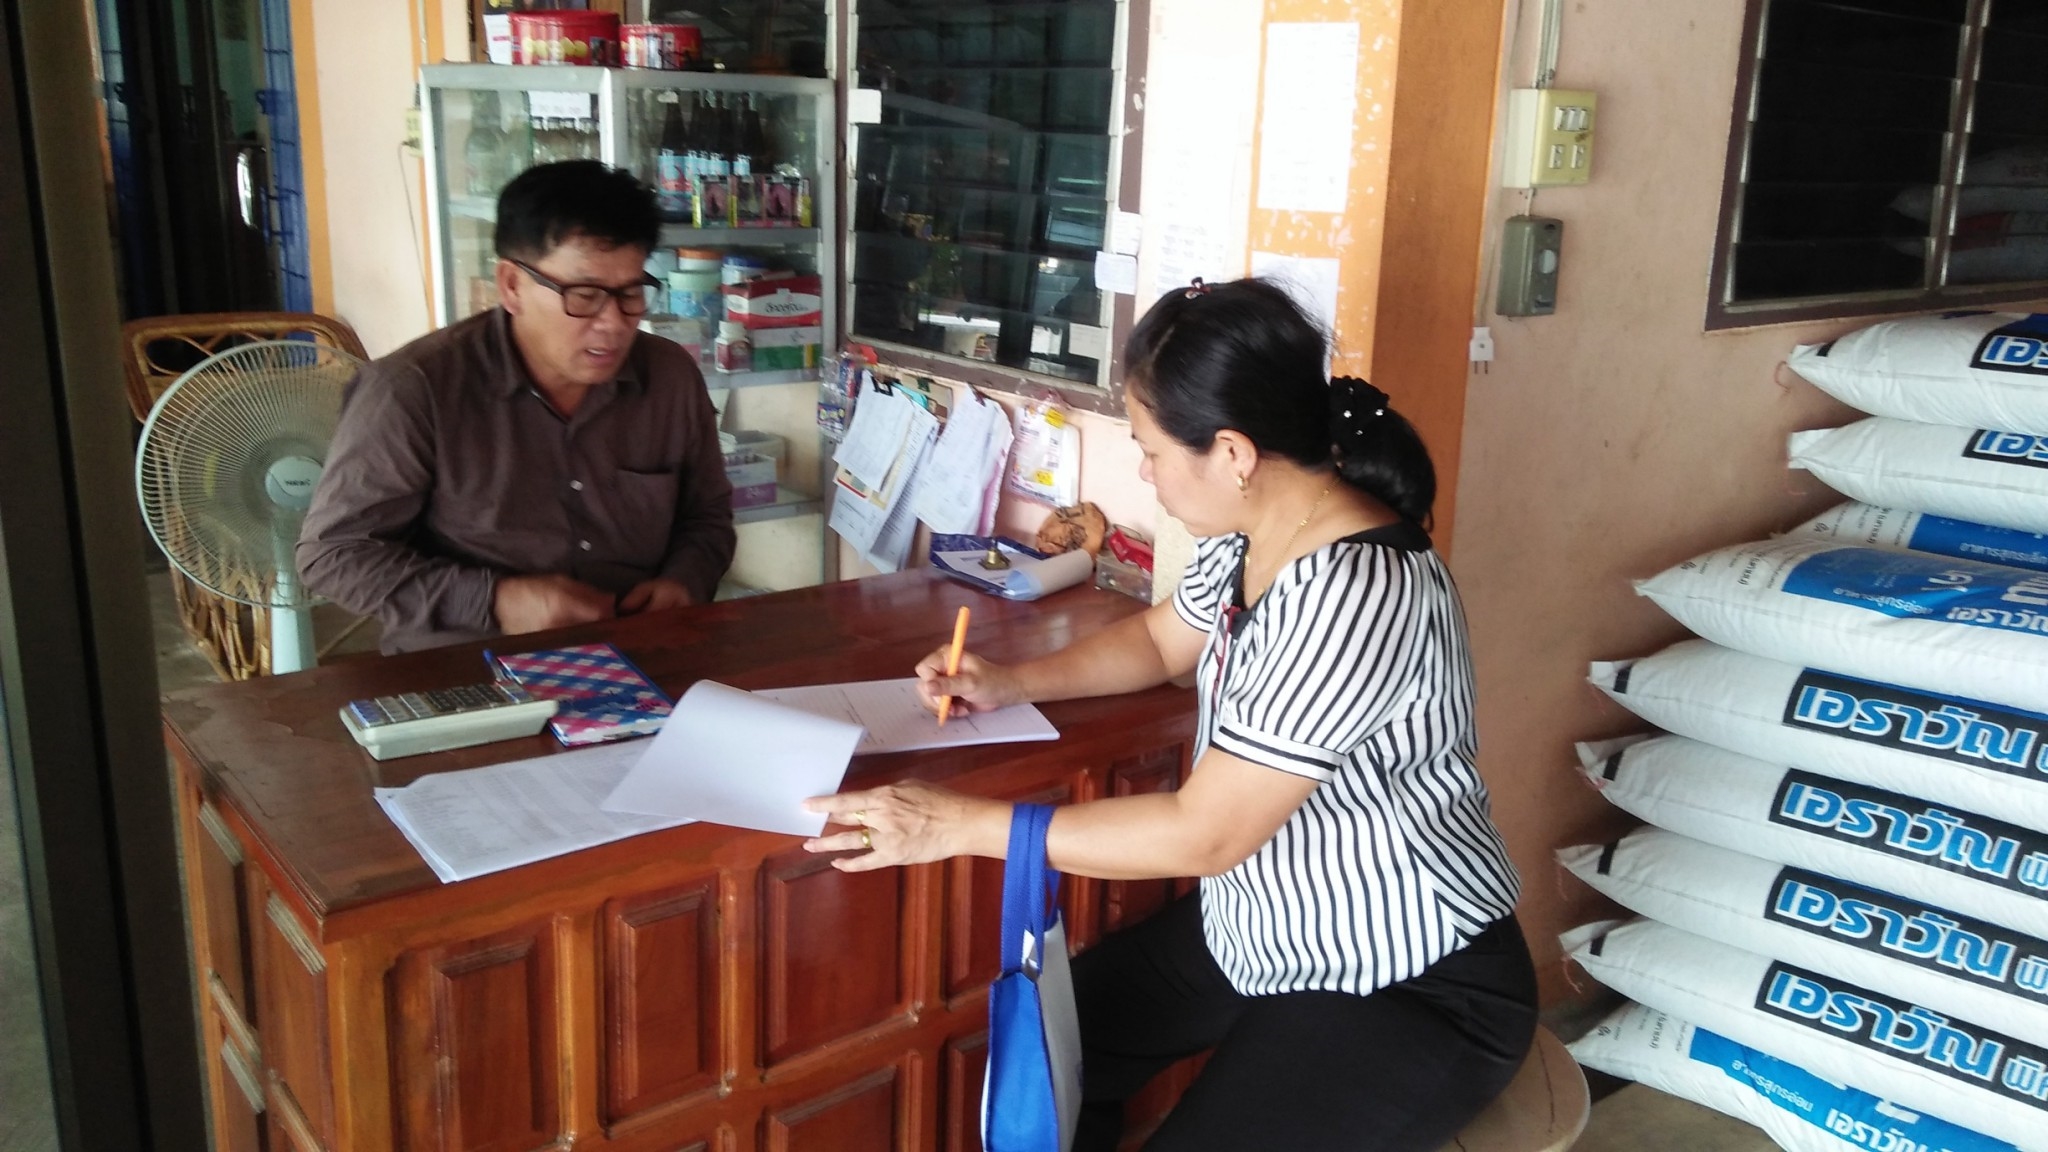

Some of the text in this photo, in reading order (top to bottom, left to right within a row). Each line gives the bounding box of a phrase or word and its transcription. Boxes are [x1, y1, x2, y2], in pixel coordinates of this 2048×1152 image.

[1793, 685, 2038, 768] เอราวัณ
[1780, 781, 2021, 879] เอราวัณ
[1774, 879, 2017, 983] เอราวัณ
[1765, 970, 2005, 1082] เอราวัณ
